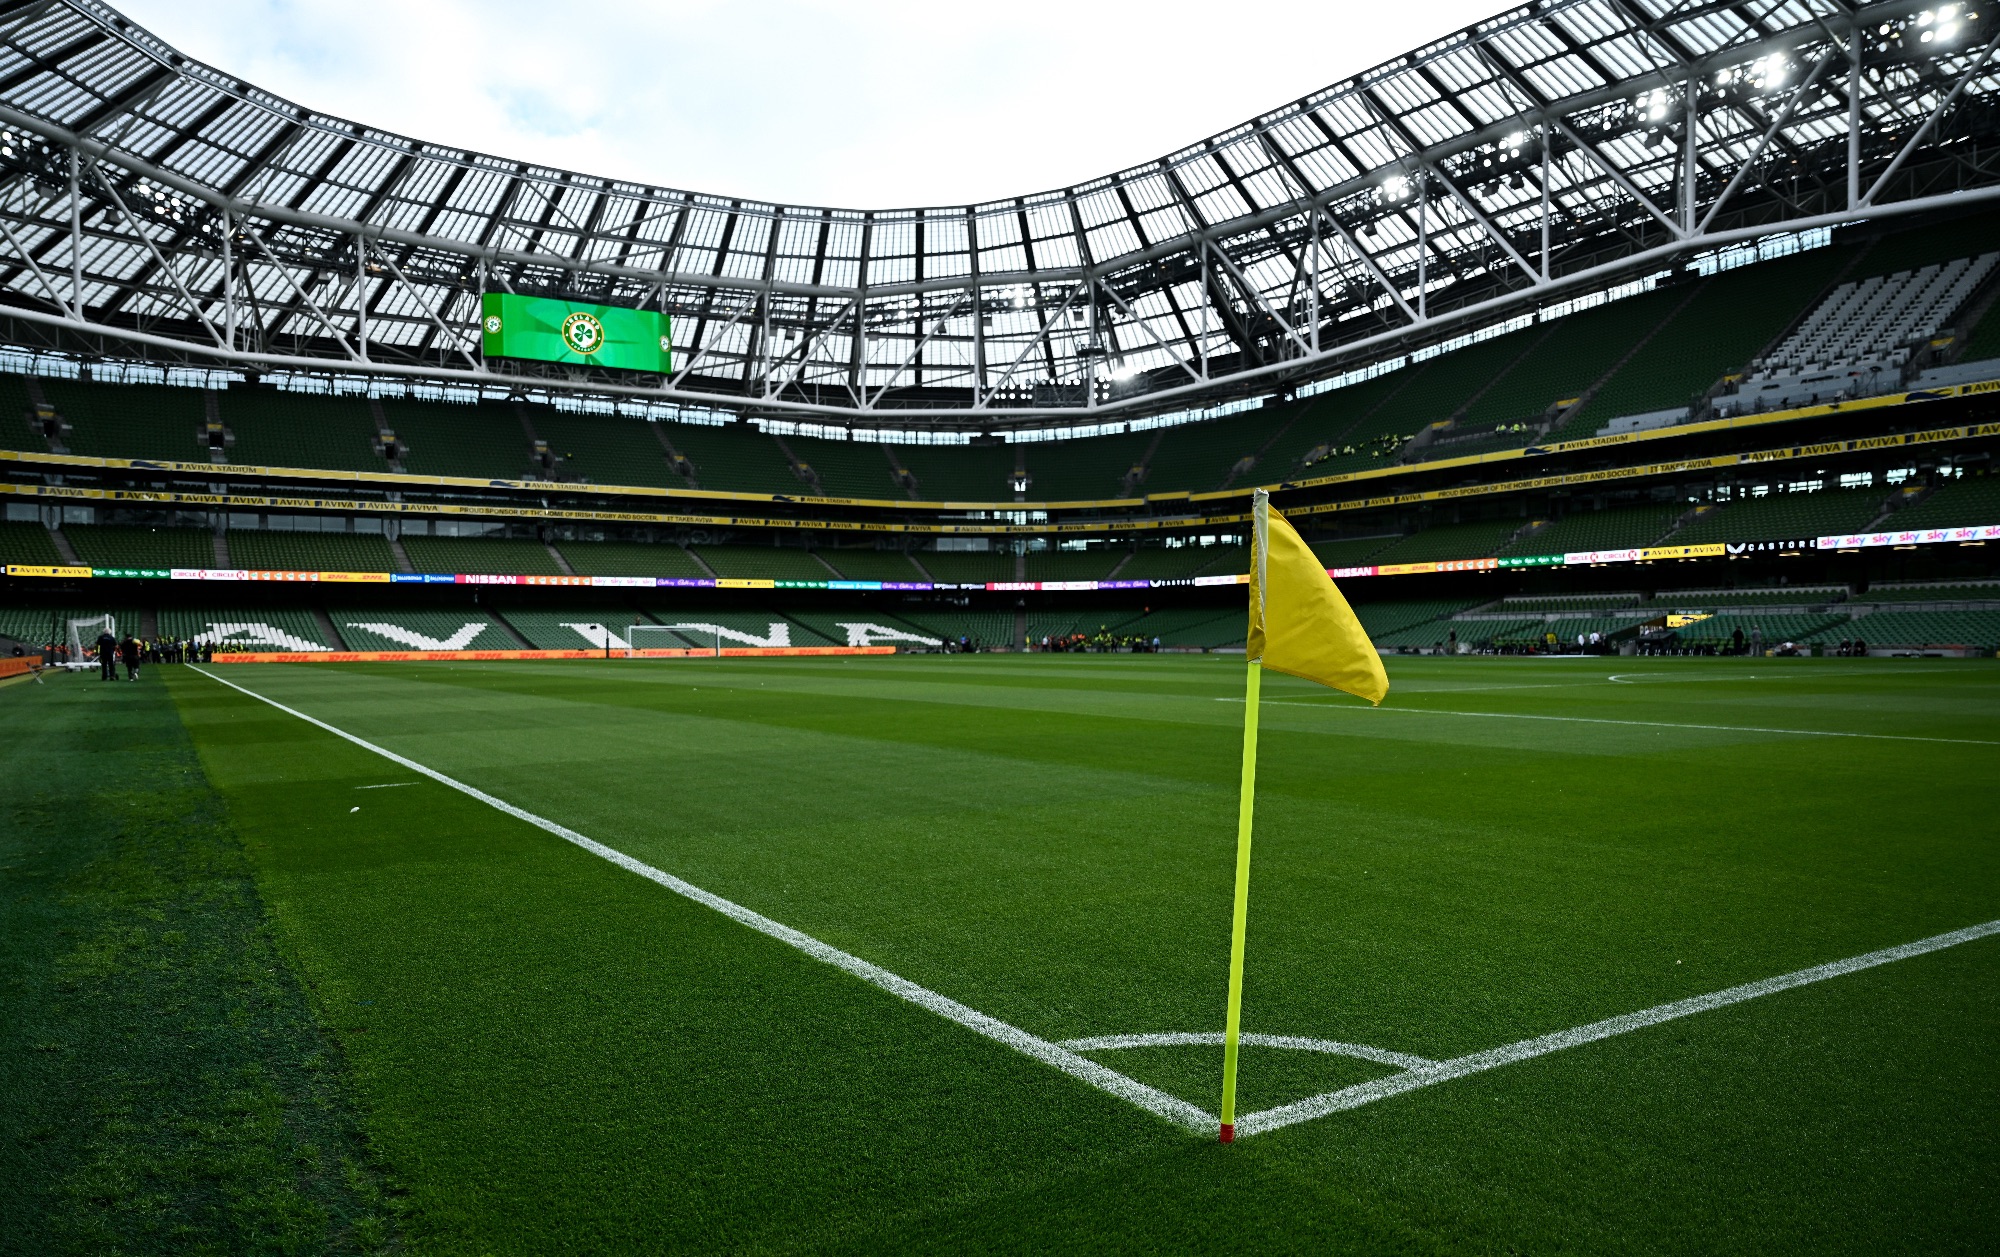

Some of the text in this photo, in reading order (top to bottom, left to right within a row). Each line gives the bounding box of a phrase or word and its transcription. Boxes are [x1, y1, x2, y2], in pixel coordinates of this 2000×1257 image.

[1918, 428, 1960, 442] AVIVA
[1566, 434, 1628, 450] AVIVA STADIUM
[1860, 436, 1898, 448] AVIVA
[1804, 443, 1841, 454] AVIVA
[1752, 450, 1786, 460] AVIVA
[216, 465, 257, 474] STADIUM
[1686, 459, 1712, 470] AVIVA
[1438, 490, 1458, 498] PROUD
[1460, 486, 1489, 496] SPONSOR
[1514, 480, 1533, 488] HOME
[1544, 476, 1563, 485] IRISH
[1565, 474, 1589, 483] RUGBY
[1590, 472, 1605, 480] AND
[50, 488, 84, 496] AVIVA
[186, 494, 218, 502] AVIVA
[232, 496, 264, 504] AVIVA
[1370, 498, 1391, 506] AVIVA
[1400, 494, 1422, 502] AVIVA
[1316, 504, 1334, 512] AVIVA
[1342, 501, 1362, 509] AVIVA
[1872, 533, 1892, 545] sky
[1899, 531, 1920, 544] sky
[1927, 530, 1949, 542] sky
[1956, 528, 1978, 540] sky
[1748, 540, 1816, 552] CASTORE
[1821, 536, 1840, 548] sky
[1846, 535, 1866, 546] sky
[1334, 567, 1372, 578] NISSAN
[466, 575, 516, 584] NISSAN
